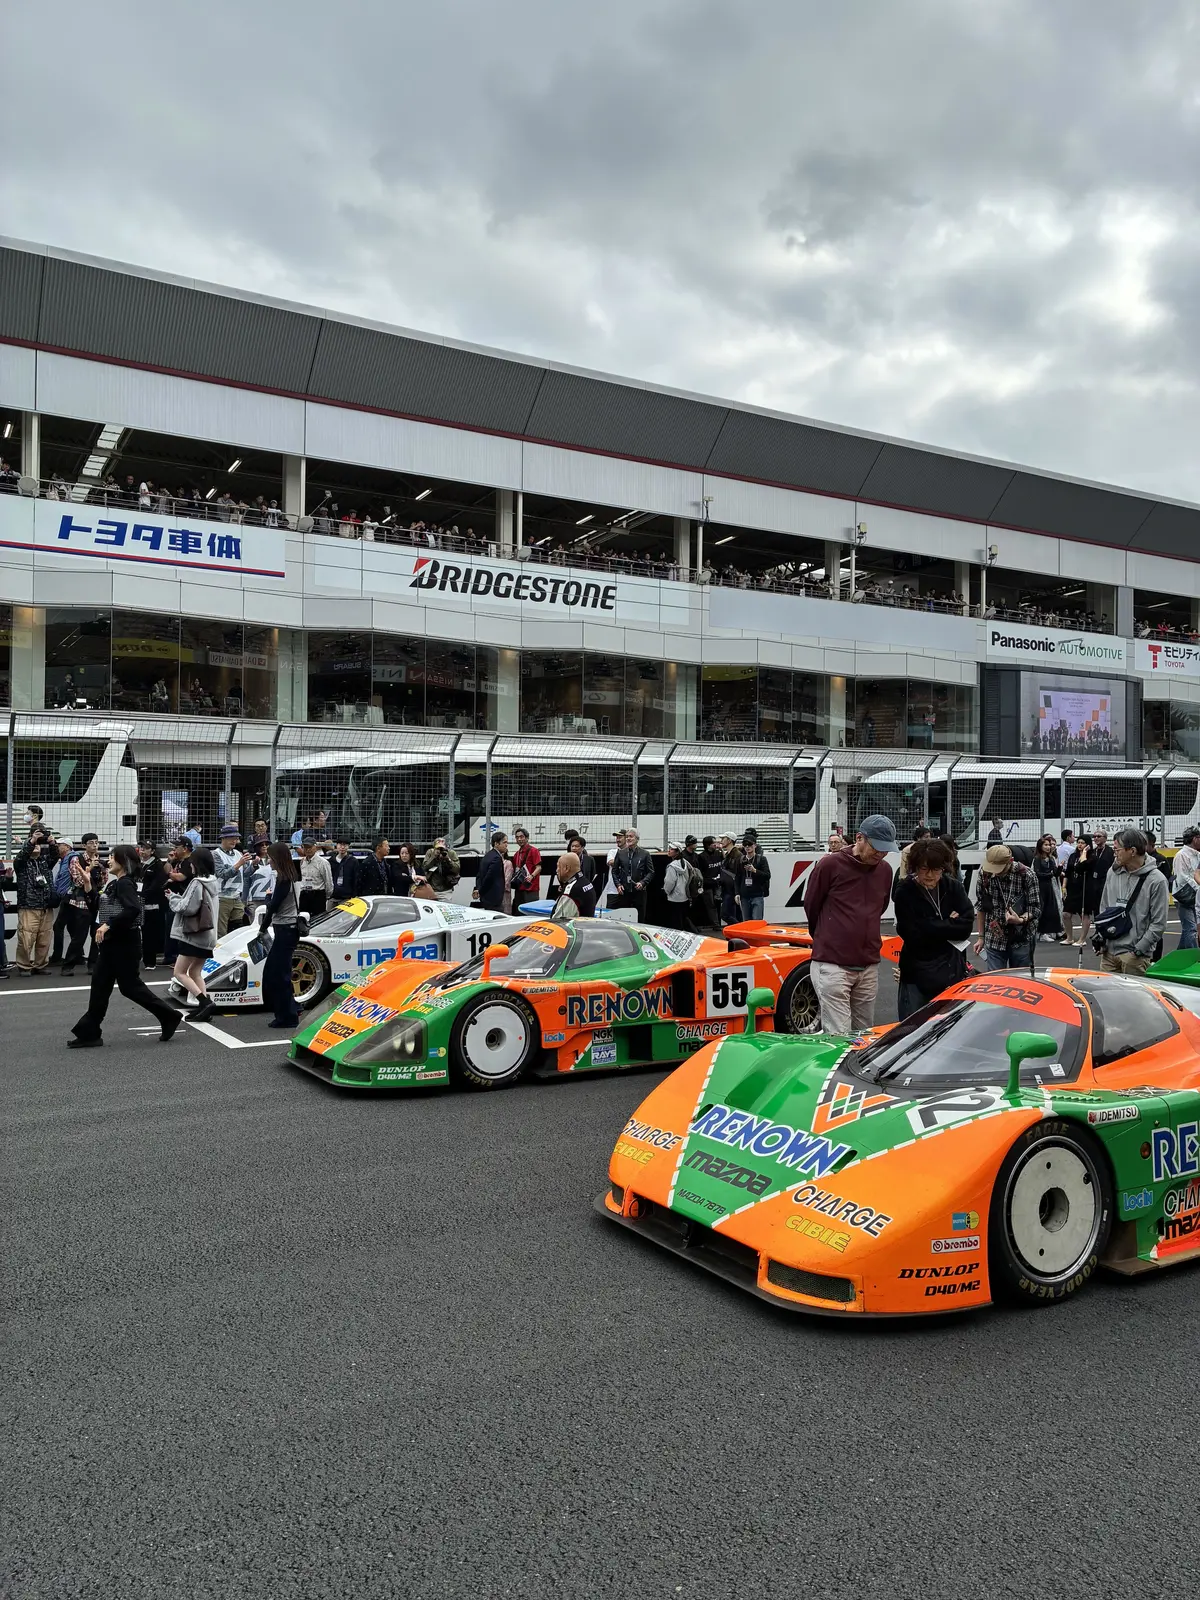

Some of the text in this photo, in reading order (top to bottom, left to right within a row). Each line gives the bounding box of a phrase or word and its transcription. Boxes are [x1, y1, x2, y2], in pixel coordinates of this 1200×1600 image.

[57, 514, 241, 560] トヨタ車体
[409, 558, 617, 610] BRIDGESTONE
[991, 630, 1122, 660] Panasonic AUTOMOTIVE
[1164, 646, 1200, 662] モビリティ
[1164, 660, 1184, 668] TOYOTA
[467, 932, 492, 959] 18
[529, 986, 558, 994] IDEMITSU
[712, 972, 748, 1009] 55
[954, 983, 1043, 1006] mazda
[337, 995, 398, 1023] RENOWN
[567, 985, 673, 1026] RENOWN
[322, 1020, 355, 1039] mazda
[593, 1029, 612, 1040] NGK
[676, 1022, 728, 1039] CHARGE
[592, 1050, 616, 1060] RAYS
[378, 1065, 426, 1073] DUNLOP
[423, 1071, 445, 1079] brembo
[1098, 1106, 1137, 1122] IDEMITSU
[622, 1119, 684, 1152] CHARGE
[689, 1104, 851, 1179] RENOWN
[1026, 1122, 1070, 1143] EAGLE
[684, 1150, 773, 1196] mazda
[677, 1188, 727, 1215] MAZDA 787B
[1164, 1185, 1200, 1217] CHA
[792, 1184, 894, 1249] CHARGE
[943, 1237, 979, 1250] brembo
[898, 1263, 980, 1279] DUNLOP
[924, 1279, 980, 1297] D40/M2
